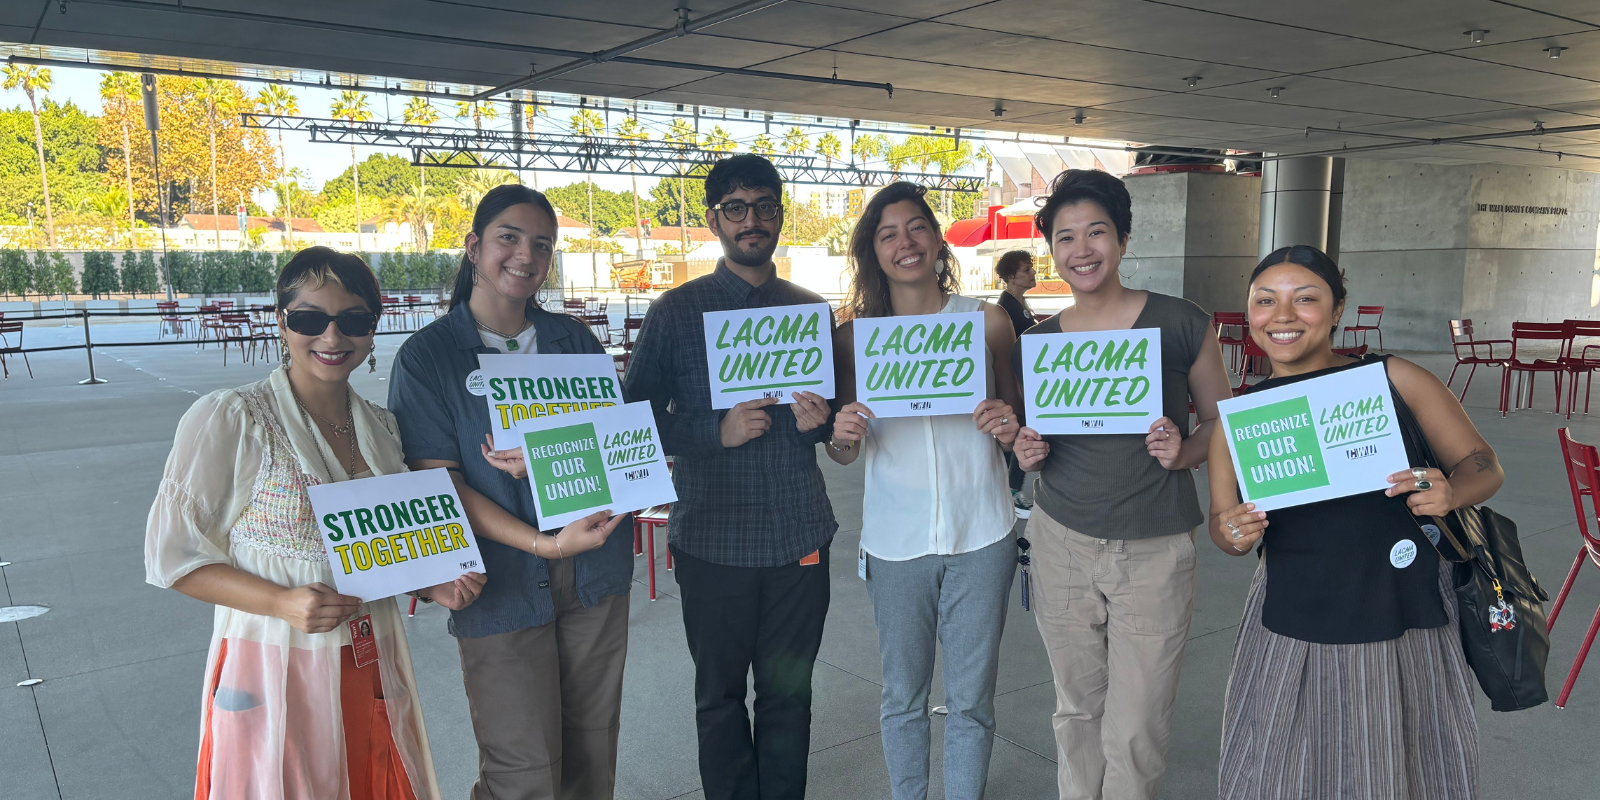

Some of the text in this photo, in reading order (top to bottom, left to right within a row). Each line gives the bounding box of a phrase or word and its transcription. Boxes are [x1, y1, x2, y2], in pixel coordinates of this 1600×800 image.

[716, 312, 819, 350] LACMA
[864, 320, 973, 357] LACMA
[718, 347, 823, 383] UNITED
[1033, 337, 1149, 374] LACMA
[488, 377, 617, 401] STRONGER
[866, 357, 975, 391] UNITED
[1035, 375, 1150, 408] UNITED
[1319, 394, 1384, 426] LACMA
[603, 427, 652, 450] LACMA
[1235, 412, 1310, 442] RECOGNIZE
[1323, 414, 1389, 444] UNITED
[531, 437, 597, 460] RECOGNIZE
[607, 444, 657, 466] UNITED
[1257, 435, 1298, 460] OUR
[551, 457, 587, 477] OUR
[1250, 454, 1316, 484] UNION!
[545, 475, 603, 501] UNION!
[323, 493, 461, 542] STRONGER
[333, 522, 470, 575] TOGETHER
[1394, 544, 1414, 557] LACMA
[1394, 551, 1415, 563] UNITED
